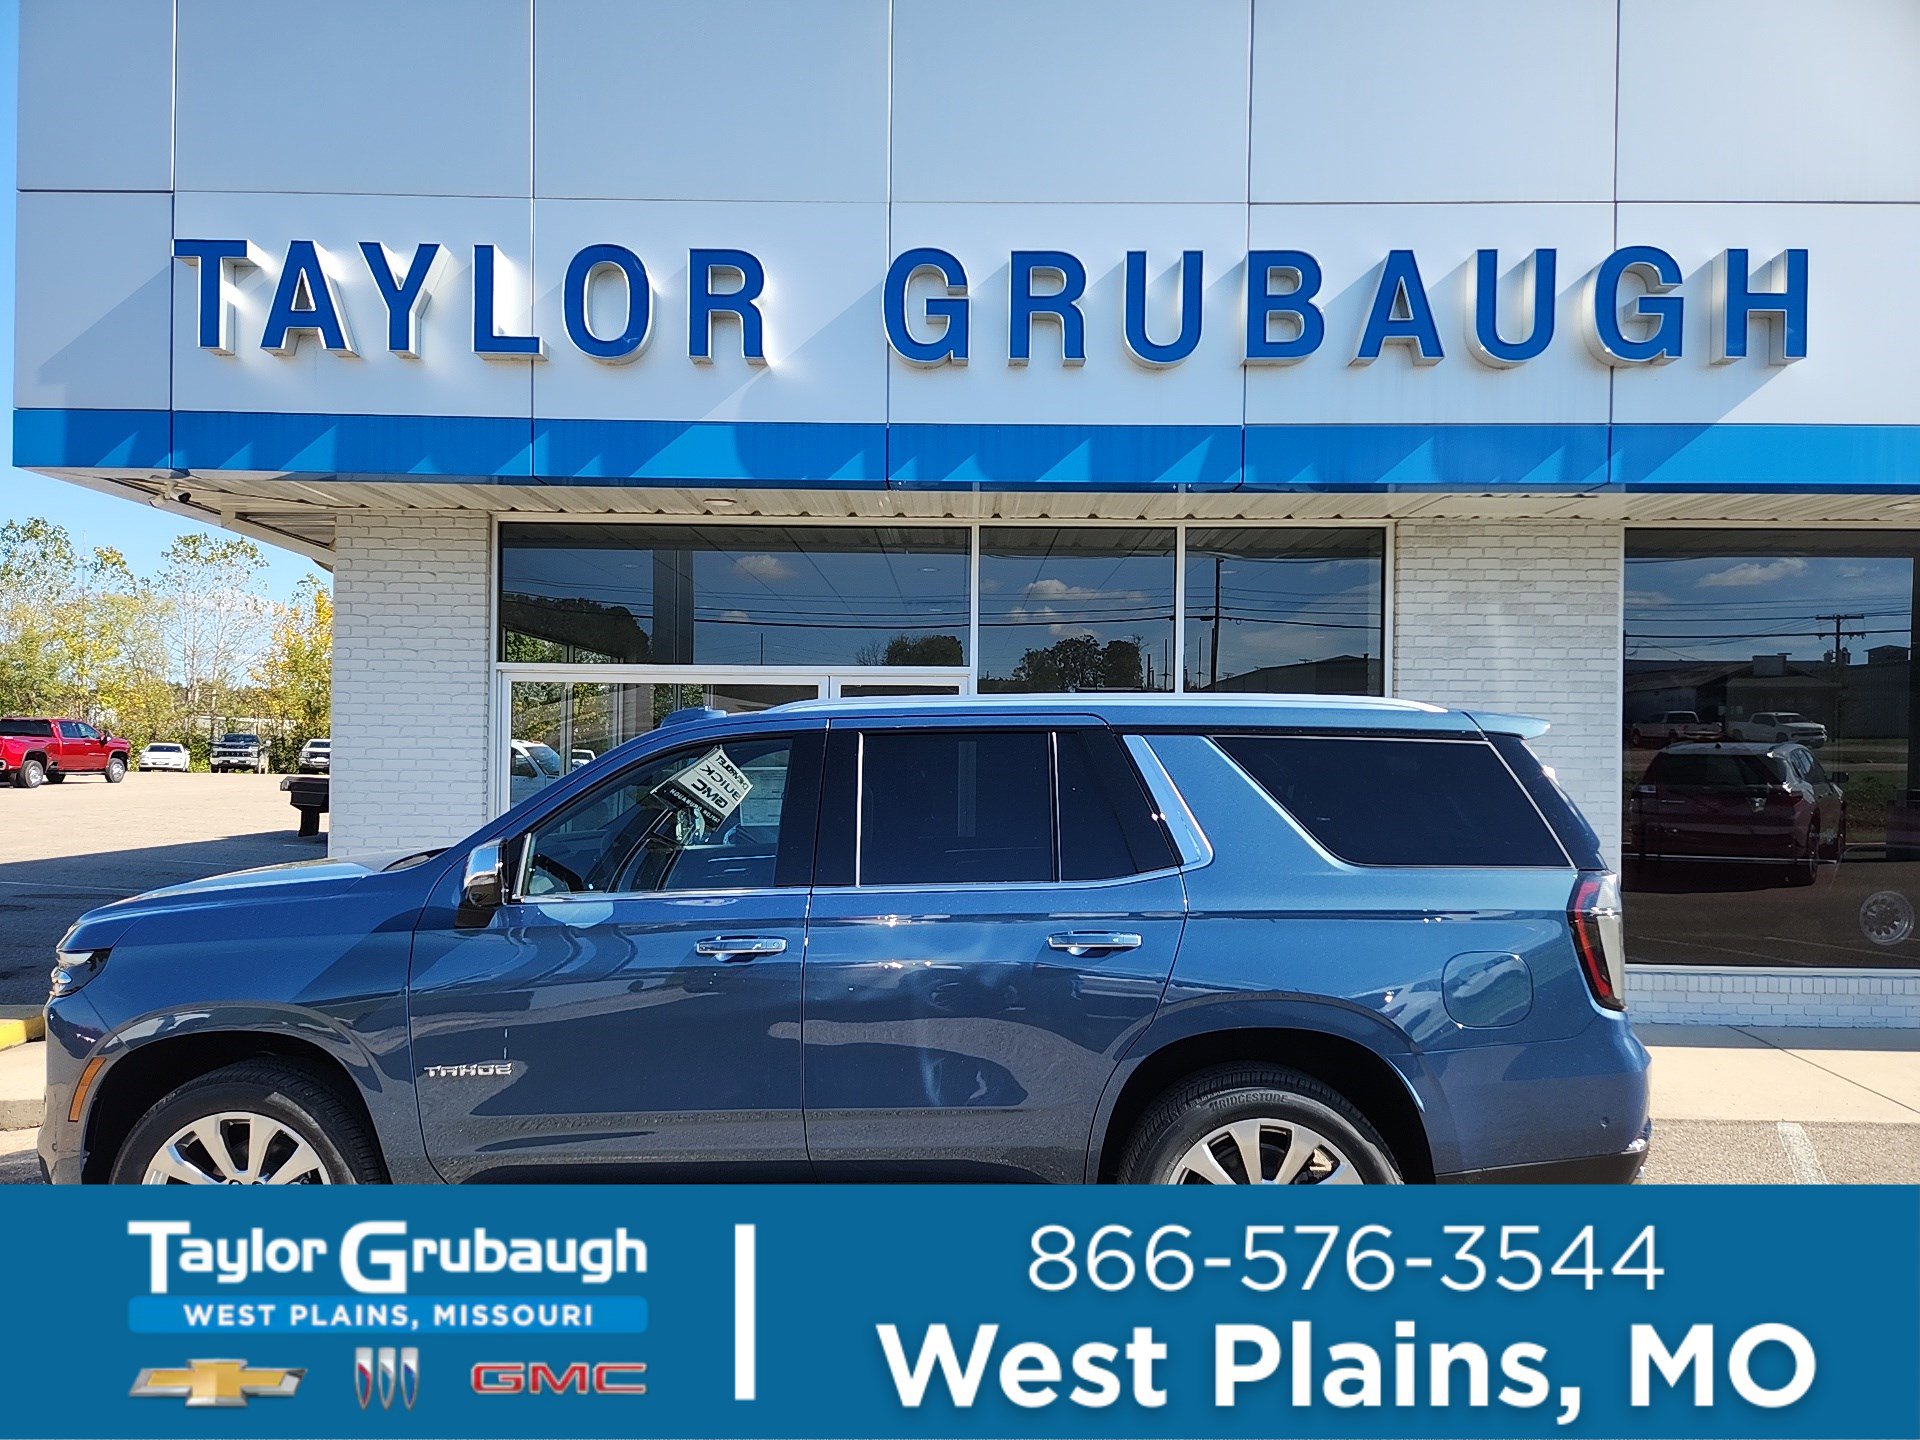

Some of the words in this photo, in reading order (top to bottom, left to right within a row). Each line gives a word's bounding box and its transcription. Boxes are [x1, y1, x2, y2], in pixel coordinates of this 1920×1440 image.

[172, 238, 768, 364] TAYLOR
[883, 246, 1808, 367] GRUBAUGH
[424, 1063, 512, 1077] TAHOE
[1208, 1092, 1290, 1111] BRIDGESTONE
